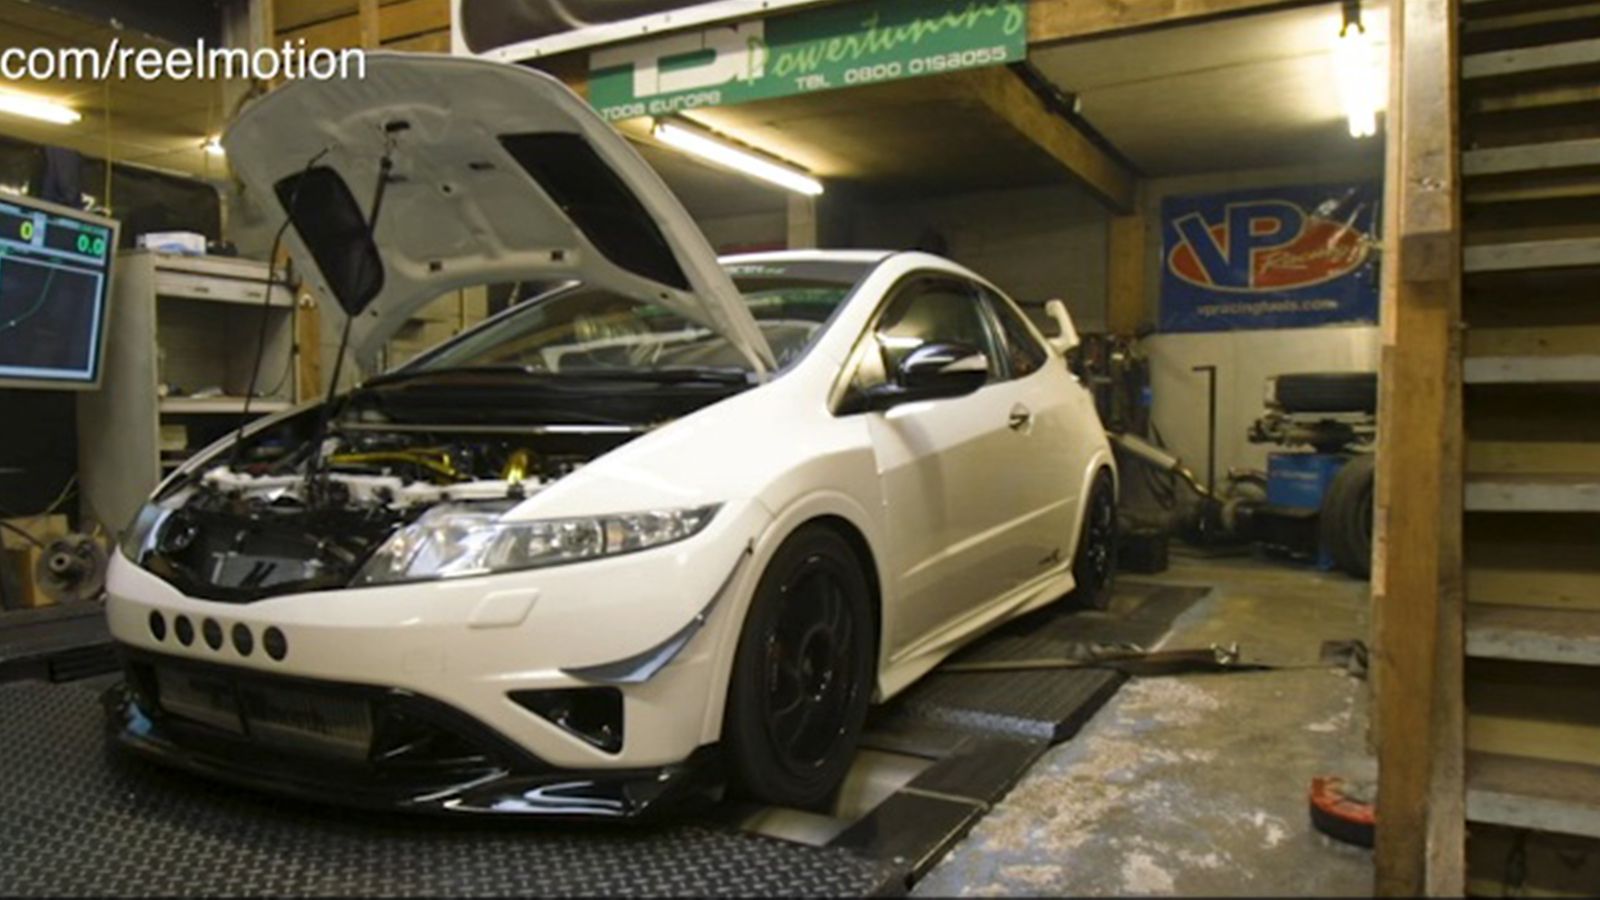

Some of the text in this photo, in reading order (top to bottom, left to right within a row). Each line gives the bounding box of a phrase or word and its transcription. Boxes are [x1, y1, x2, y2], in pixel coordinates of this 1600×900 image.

[795, 75, 830, 91] TEL
[843, 62, 901, 84] 0800
[20, 221, 34, 240] 0
[77, 234, 105, 256] 0.0
[1173, 200, 1307, 290] VP
